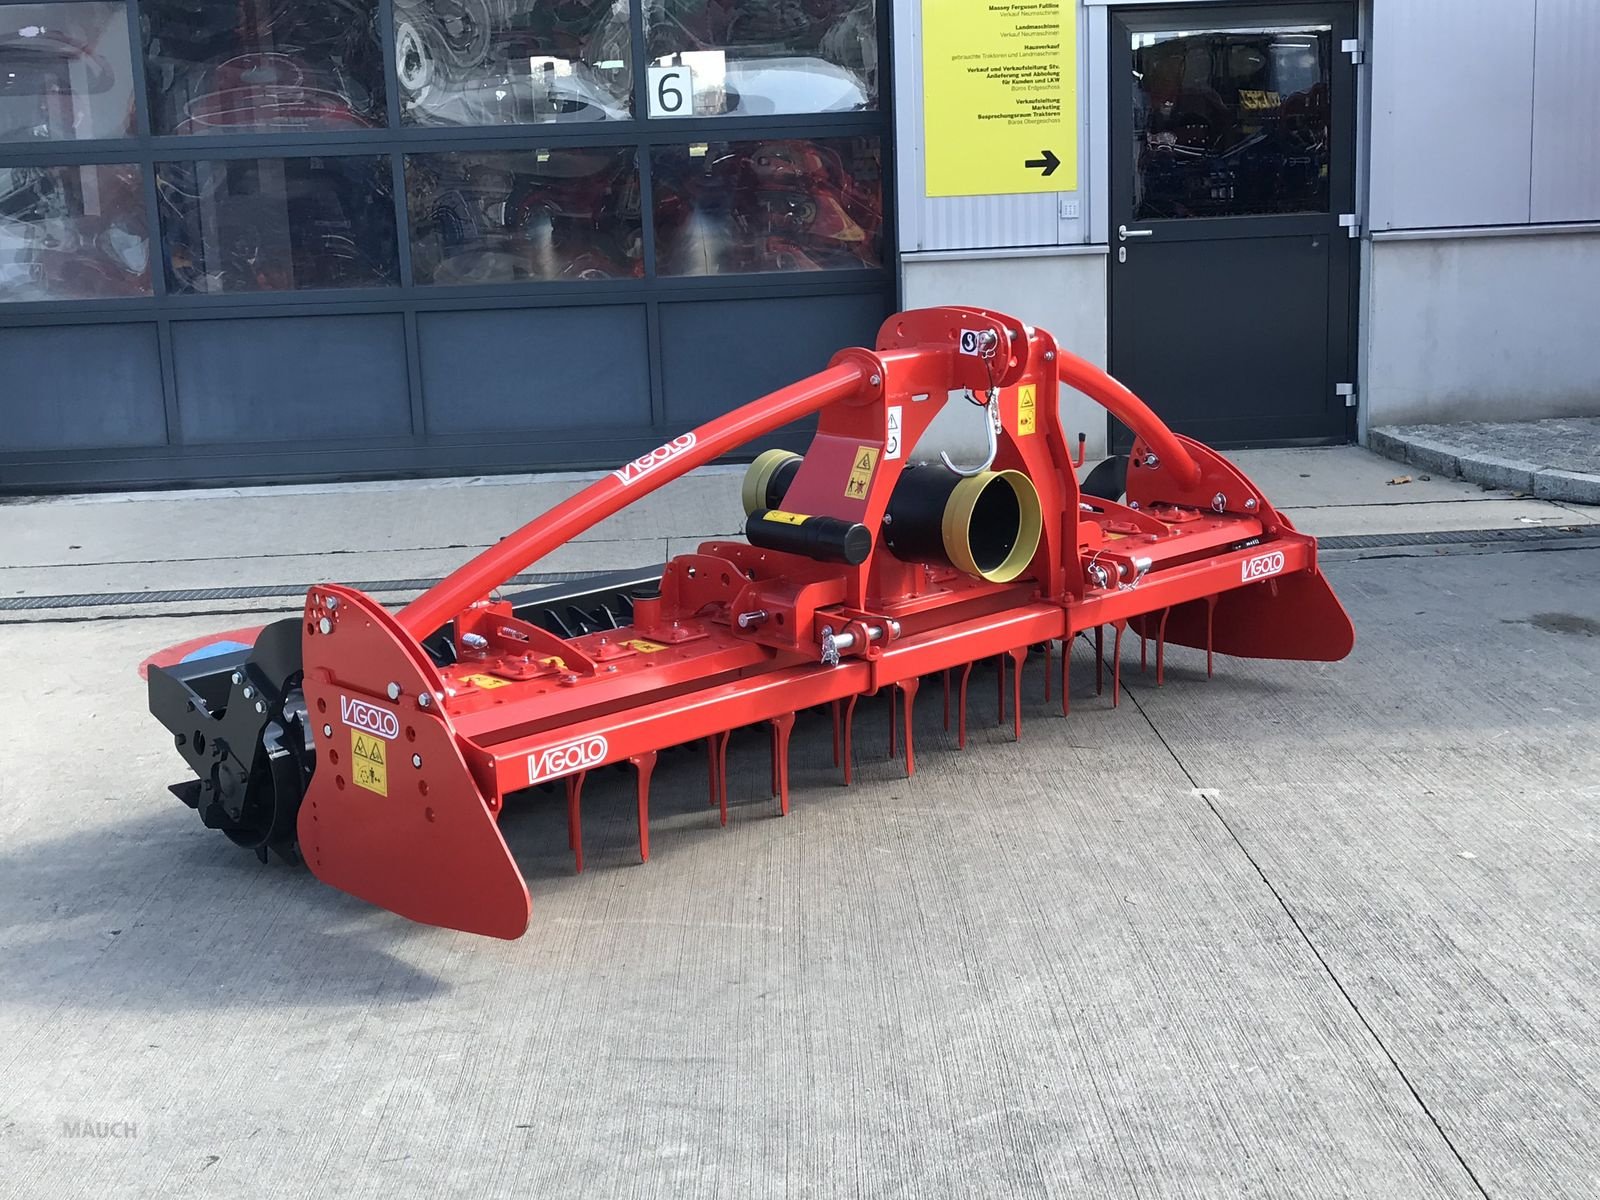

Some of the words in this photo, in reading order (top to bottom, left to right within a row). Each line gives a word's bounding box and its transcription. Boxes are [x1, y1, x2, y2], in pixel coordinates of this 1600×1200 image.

[658, 72, 682, 112] 6
[614, 432, 695, 484] VIGOLO
[1242, 551, 1283, 581] VIGOLO
[341, 695, 398, 737] VIGOLO
[528, 736, 607, 783] VIGOLO
